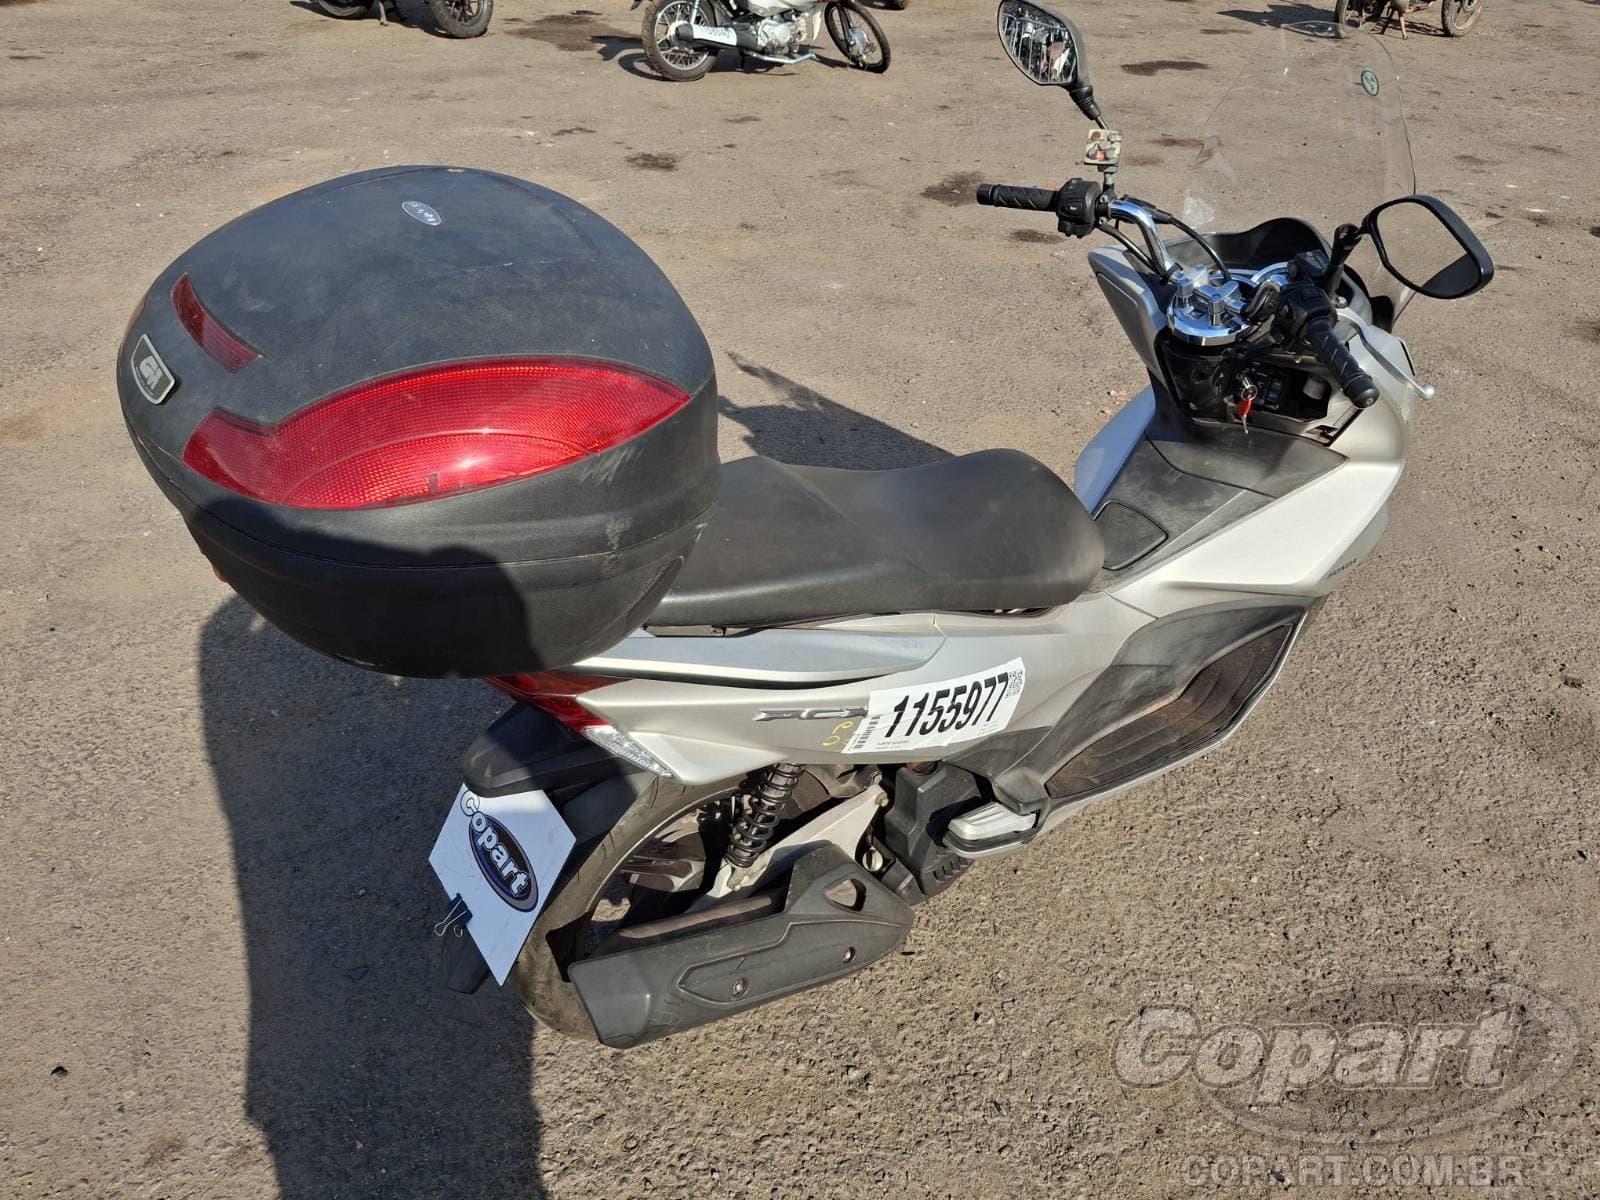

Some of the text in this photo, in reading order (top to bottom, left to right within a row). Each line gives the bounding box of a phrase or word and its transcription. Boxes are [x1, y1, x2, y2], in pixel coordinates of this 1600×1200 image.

[1326, 558, 1357, 580] HONDA
[885, 672, 1009, 738] 1155977
[460, 790, 531, 898] Copart
